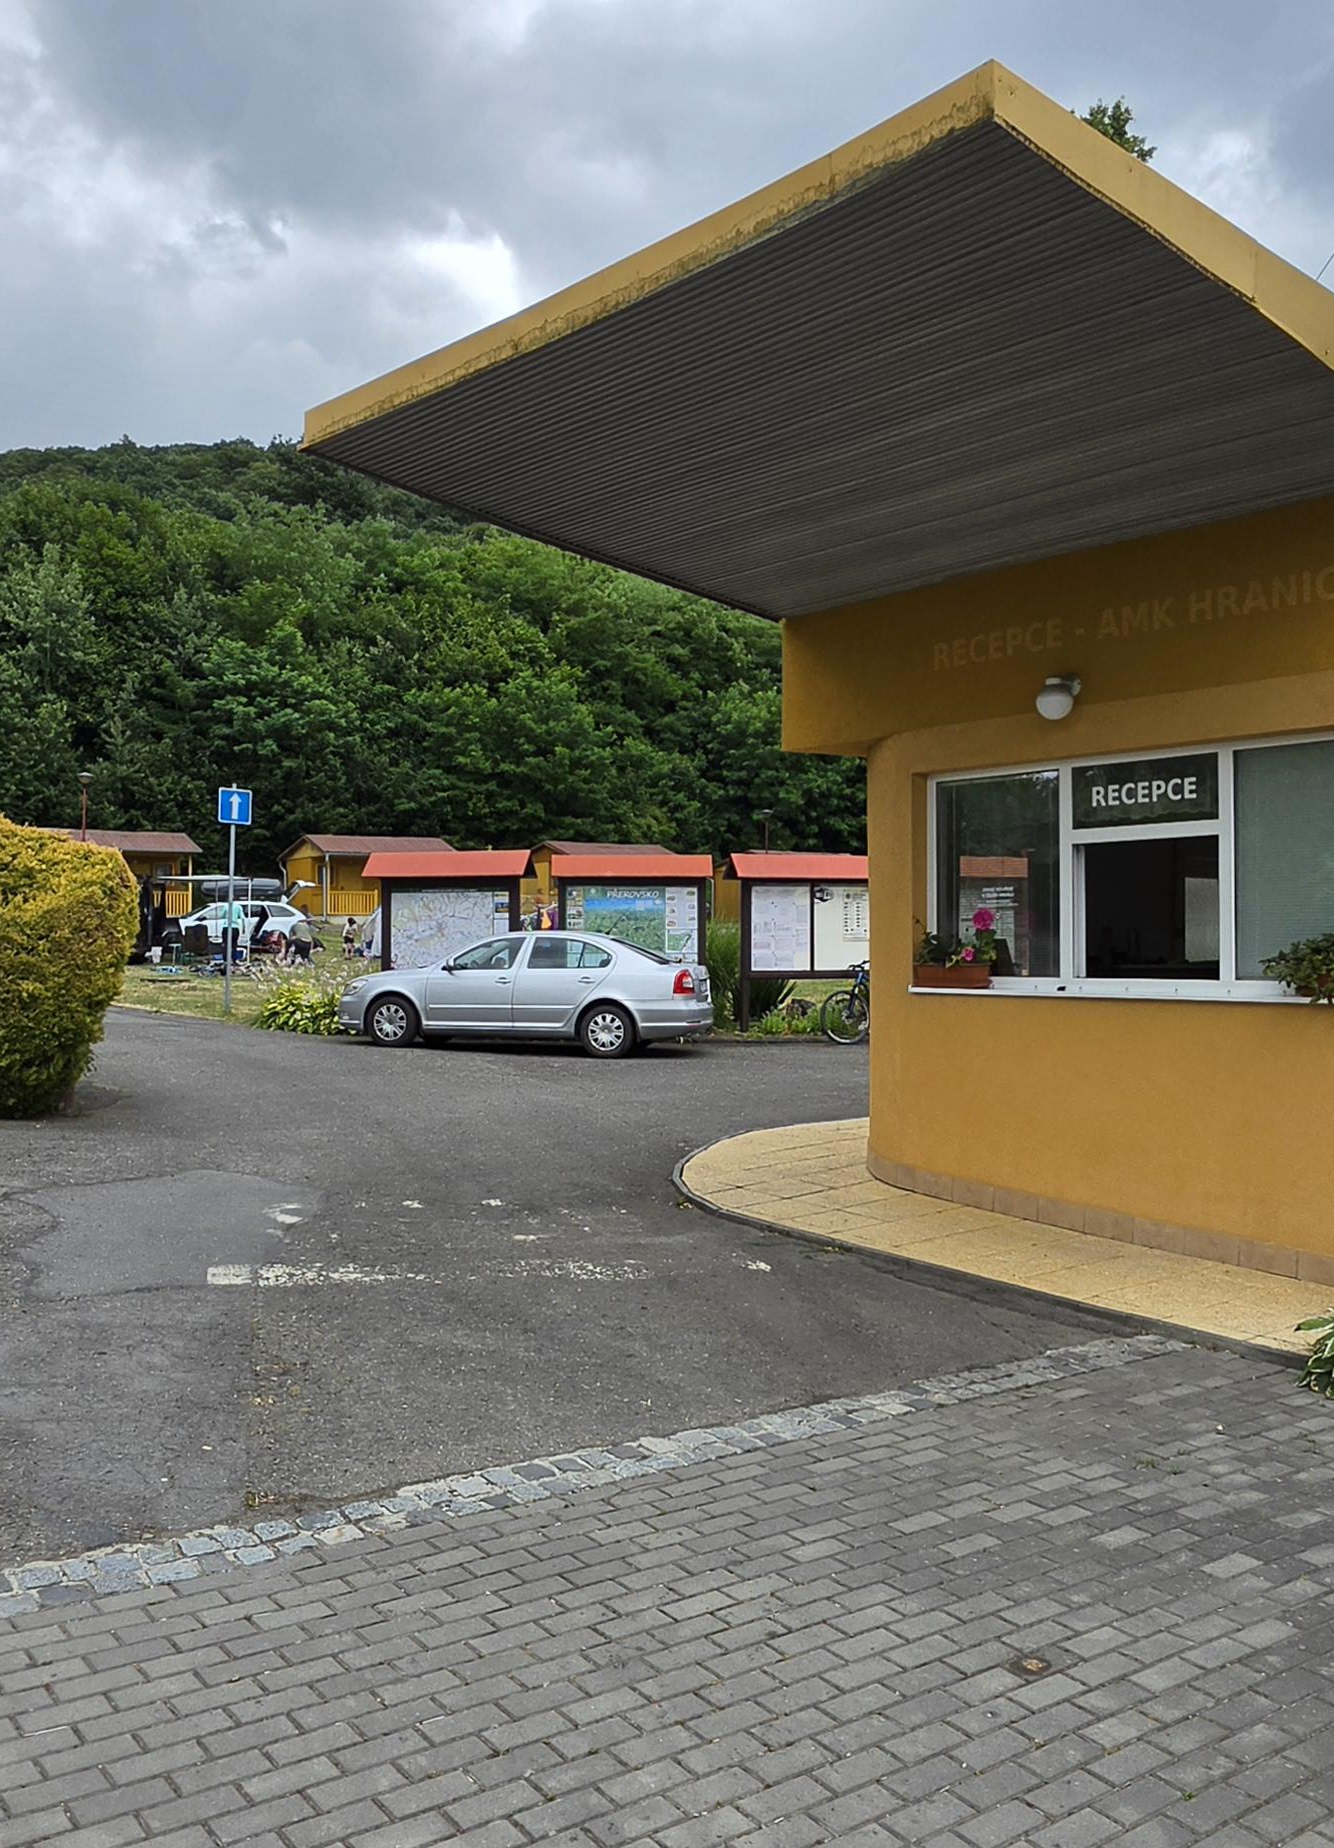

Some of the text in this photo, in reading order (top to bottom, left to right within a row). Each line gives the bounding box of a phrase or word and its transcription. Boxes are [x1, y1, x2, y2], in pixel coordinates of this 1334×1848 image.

[933, 619, 1063, 670] RECEPCE
[1099, 600, 1176, 639] AMK
[1091, 776, 1197, 808] RECEPCE
